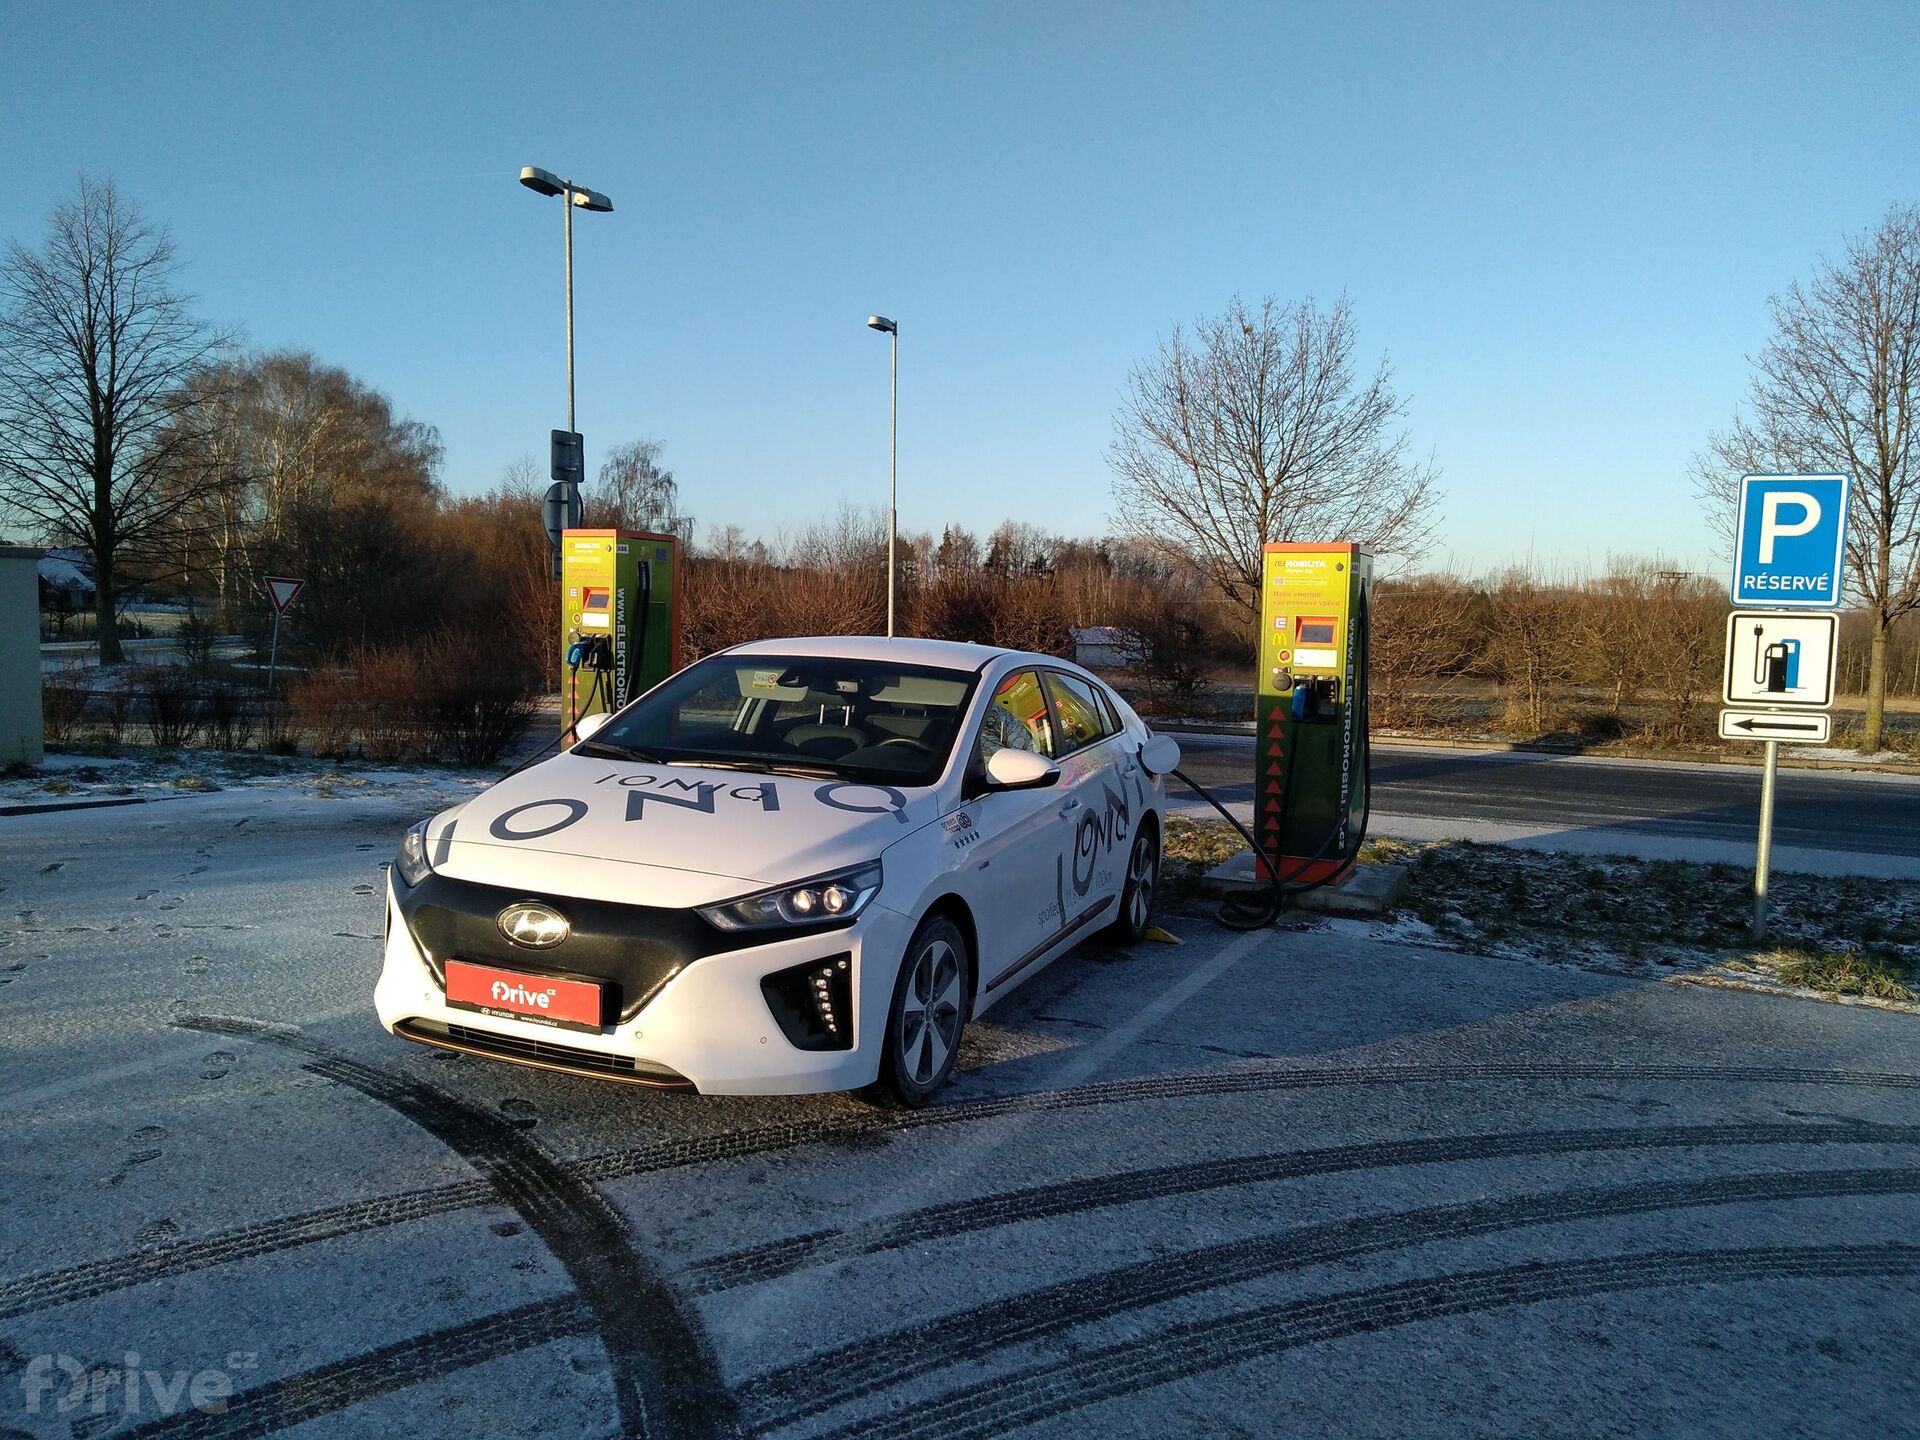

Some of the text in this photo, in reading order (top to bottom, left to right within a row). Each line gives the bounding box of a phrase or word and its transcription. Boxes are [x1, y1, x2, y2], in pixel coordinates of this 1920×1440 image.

[1758, 491, 1822, 564] P
[1744, 572, 1829, 592] RÉSERVÉ
[594, 773, 770, 801] IONIQ
[433, 783, 910, 865] IONIQ
